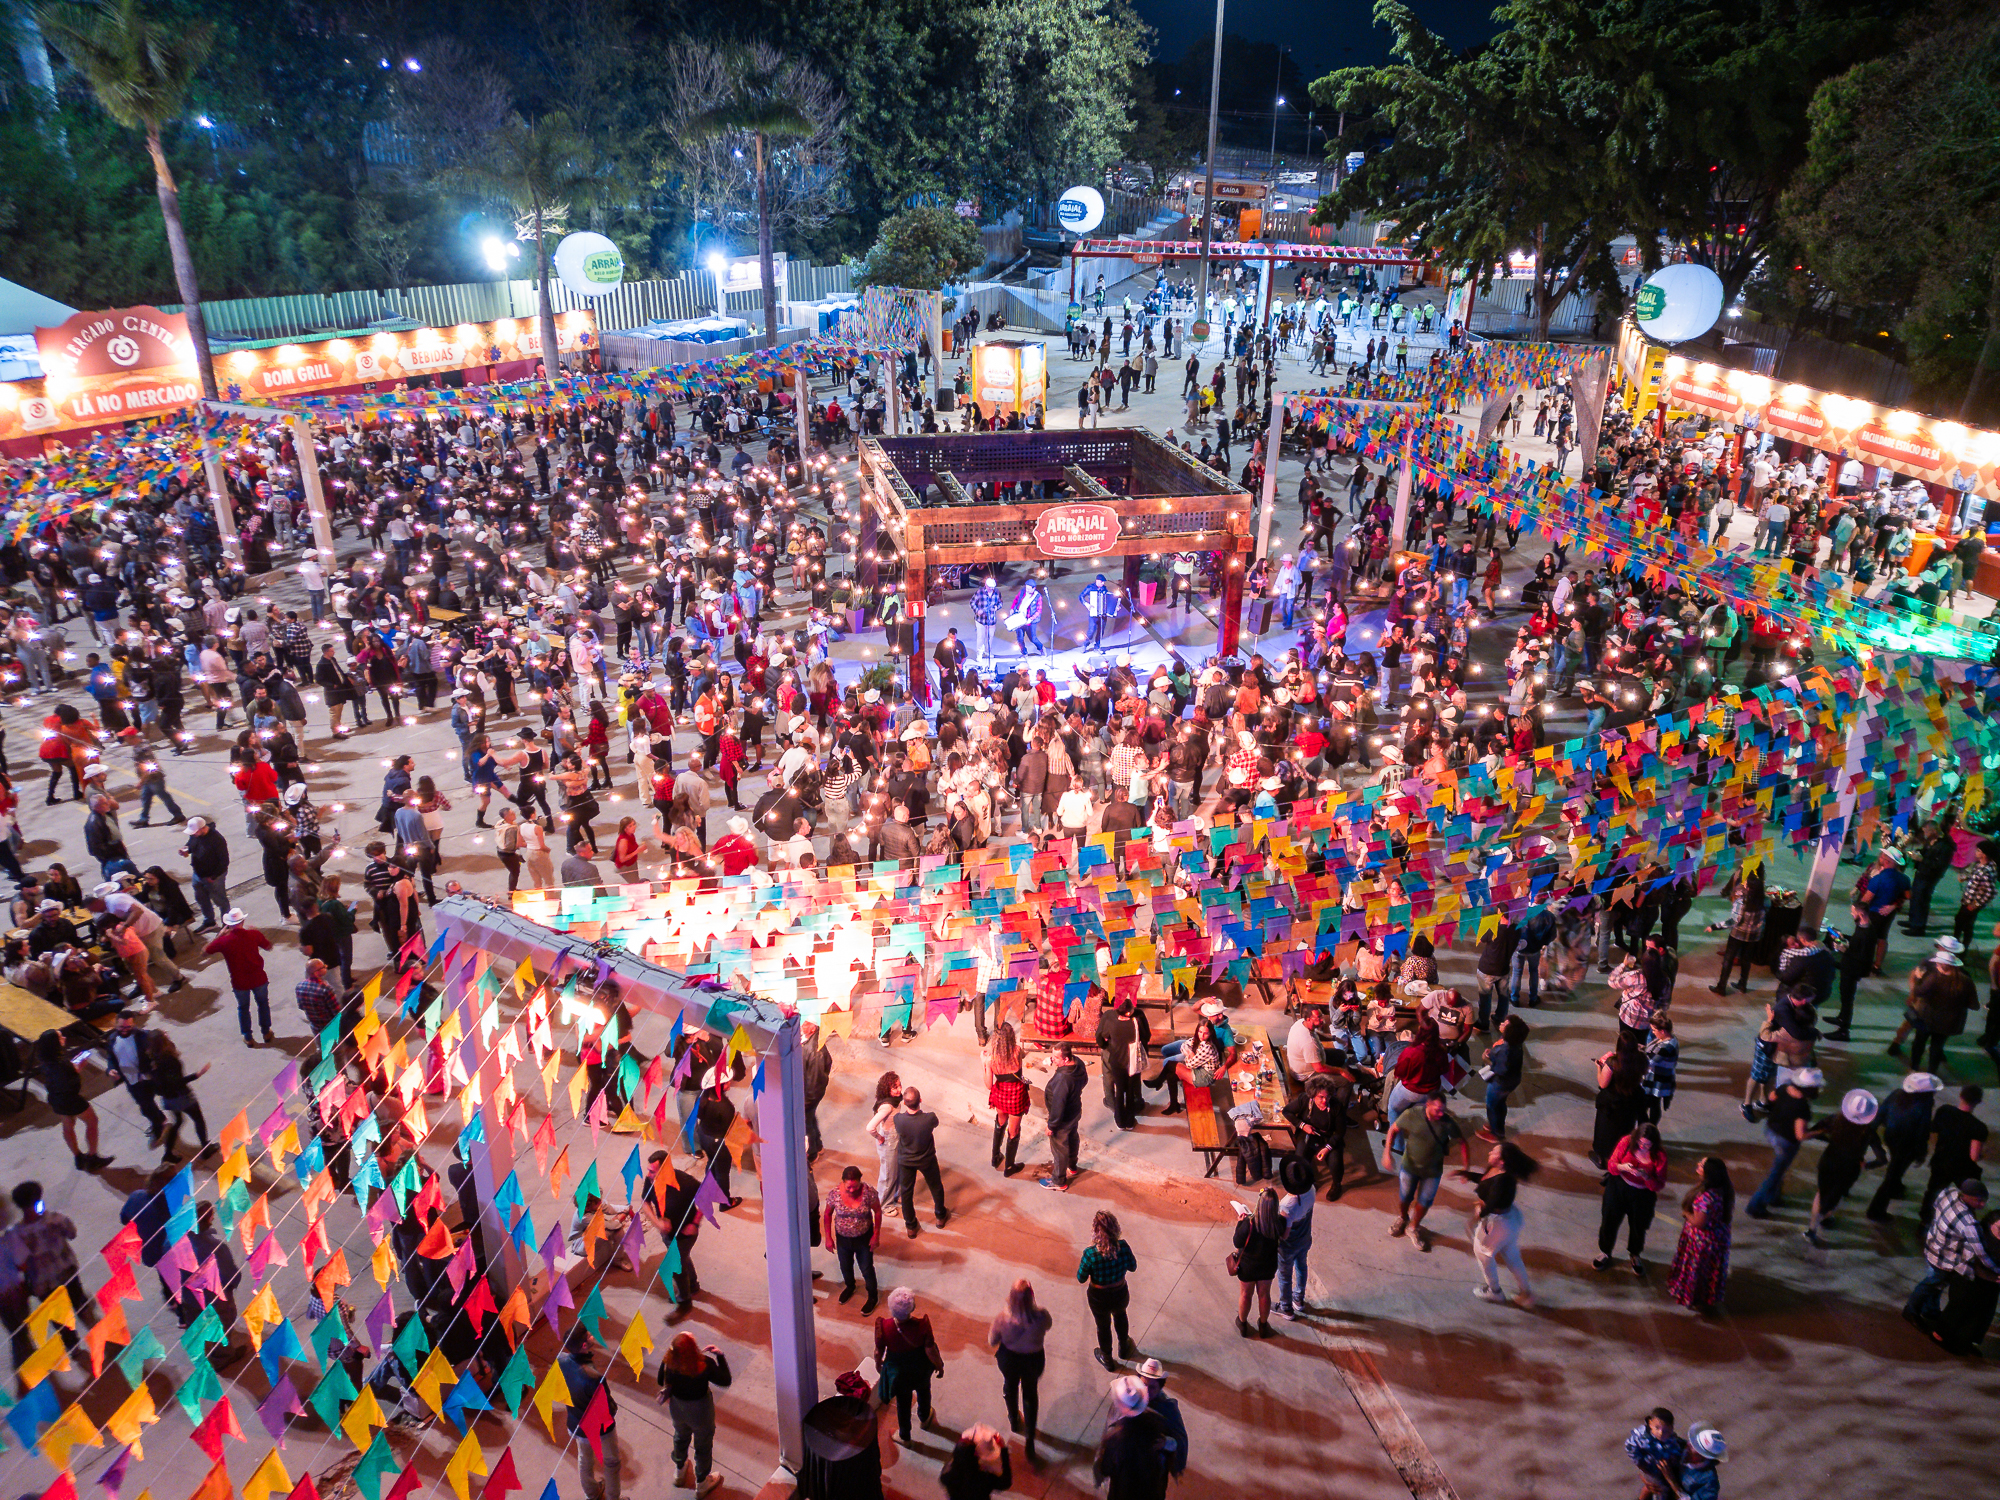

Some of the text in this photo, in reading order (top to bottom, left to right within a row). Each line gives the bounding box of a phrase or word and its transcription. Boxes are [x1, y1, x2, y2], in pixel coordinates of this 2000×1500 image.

[1222, 185, 1240, 194] SAÍDA
[1138, 254, 1158, 263] SAÍDA
[411, 347, 454, 365] BEBIDAS
[262, 368, 294, 388] BOM
[297, 362, 333, 383] GRILL
[71, 383, 198, 417] LÁ NO MERCADO
[1675, 381, 1693, 393] CENTRO
[1692, 385, 1727, 402] UNIVERSITÁRIO
[1769, 406, 1824, 429] FACULDADE ARNALDO
[1861, 431, 1941, 462] FACULDADE ESTÁCIO DE SÁ
[1068, 534, 1105, 542] HORIZONTE
